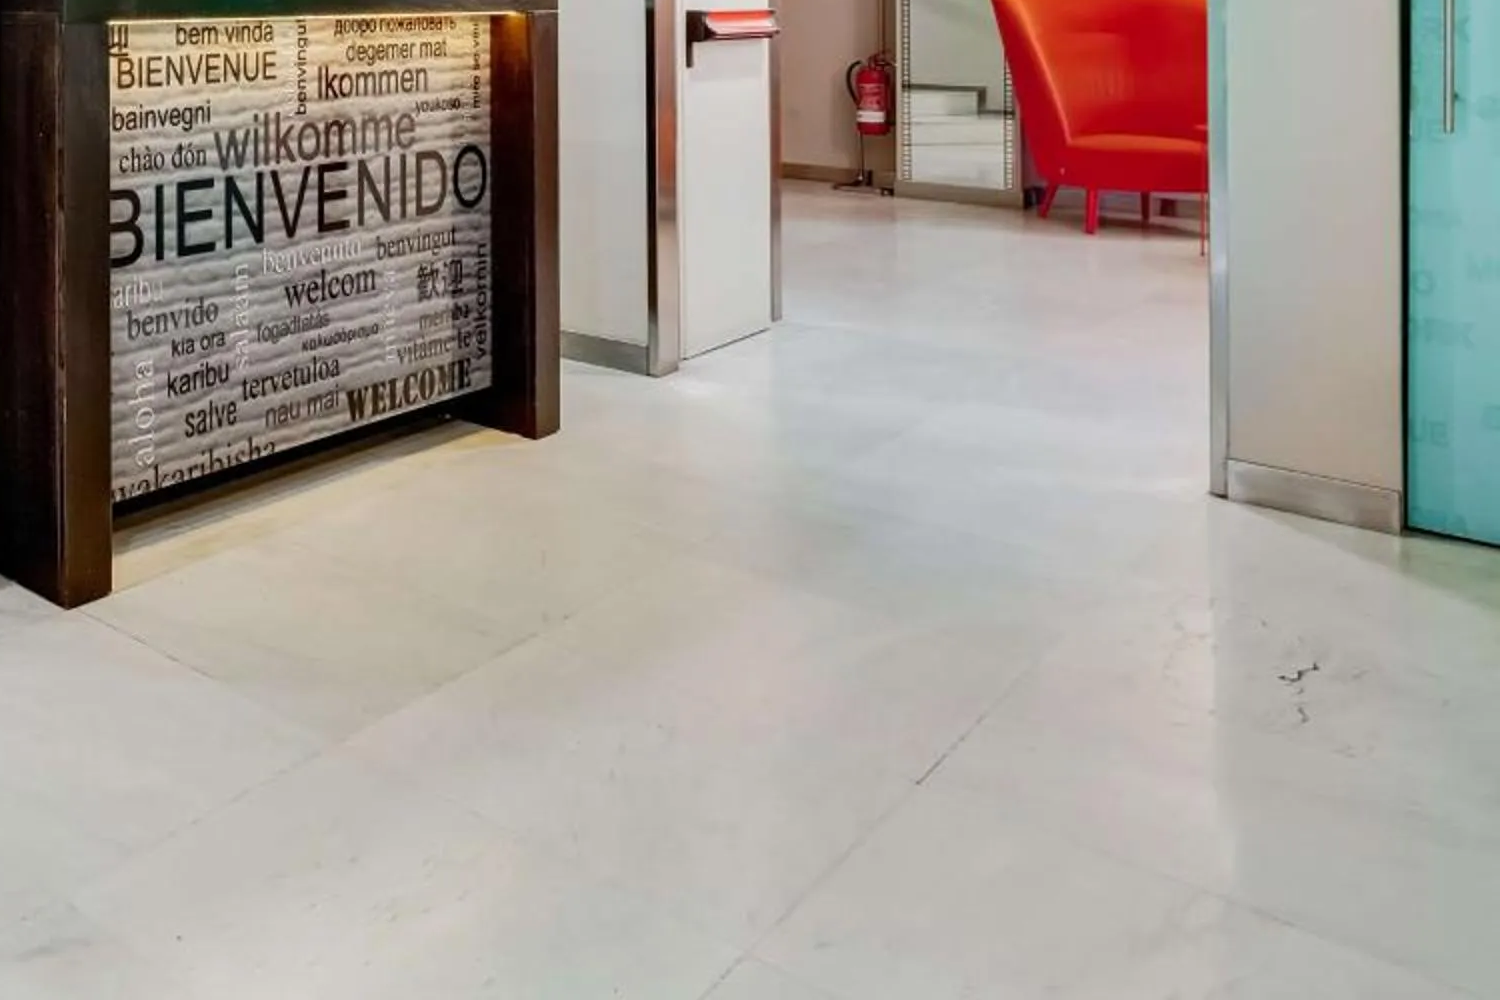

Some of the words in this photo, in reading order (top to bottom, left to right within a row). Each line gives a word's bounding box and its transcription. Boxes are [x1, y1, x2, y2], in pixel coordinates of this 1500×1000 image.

[176, 23, 219, 46] bem
[225, 20, 274, 43] vinda
[346, 40, 416, 66] degemer
[419, 37, 448, 58] mat
[117, 51, 278, 90] BIENVENUE
[112, 99, 212, 132] bainvegni
[119, 146, 165, 174] chào
[171, 141, 207, 170] đón
[213, 111, 417, 171] wilkomme
[110, 144, 487, 269] BIENVENIDO
[376, 224, 457, 260] benvingut
[111, 274, 164, 310] aribu
[284, 268, 377, 308] welcom
[473, 243, 488, 360] velkomin
[127, 296, 219, 341] benvido
[171, 338, 196, 358] kia
[199, 331, 227, 351] ora
[167, 361, 230, 399] karibu
[346, 357, 472, 423] WELCOME
[128, 359, 155, 468] aloha
[184, 399, 238, 438] salve
[264, 402, 300, 428] nau
[307, 383, 340, 414] mai
